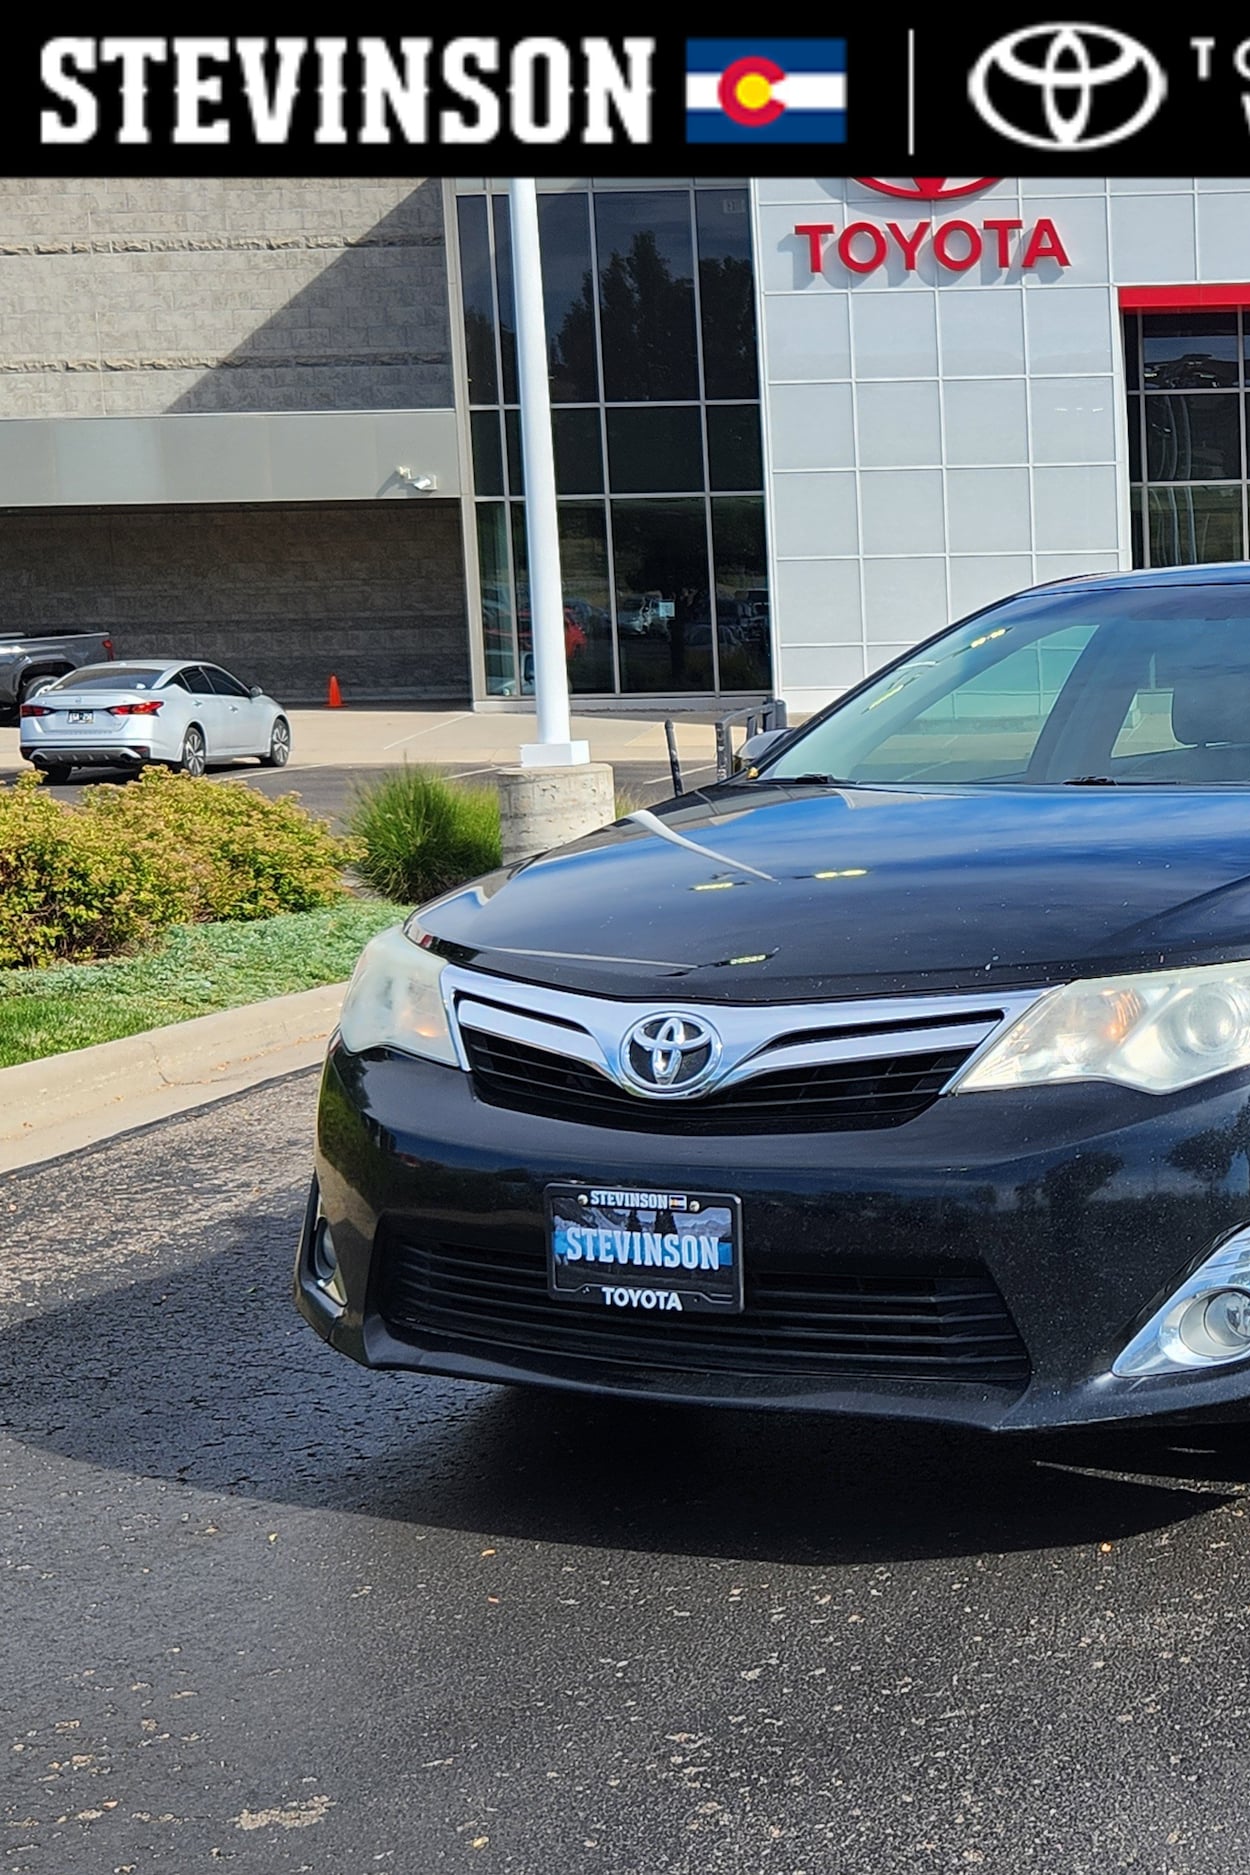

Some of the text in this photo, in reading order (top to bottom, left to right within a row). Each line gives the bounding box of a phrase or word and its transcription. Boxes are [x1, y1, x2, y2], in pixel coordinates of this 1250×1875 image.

[794, 217, 1071, 273] TOYOTA
[590, 1190, 669, 1210] STEVINSON
[566, 1227, 720, 1271] STEVINSON
[601, 1286, 683, 1311] TOYOTA
